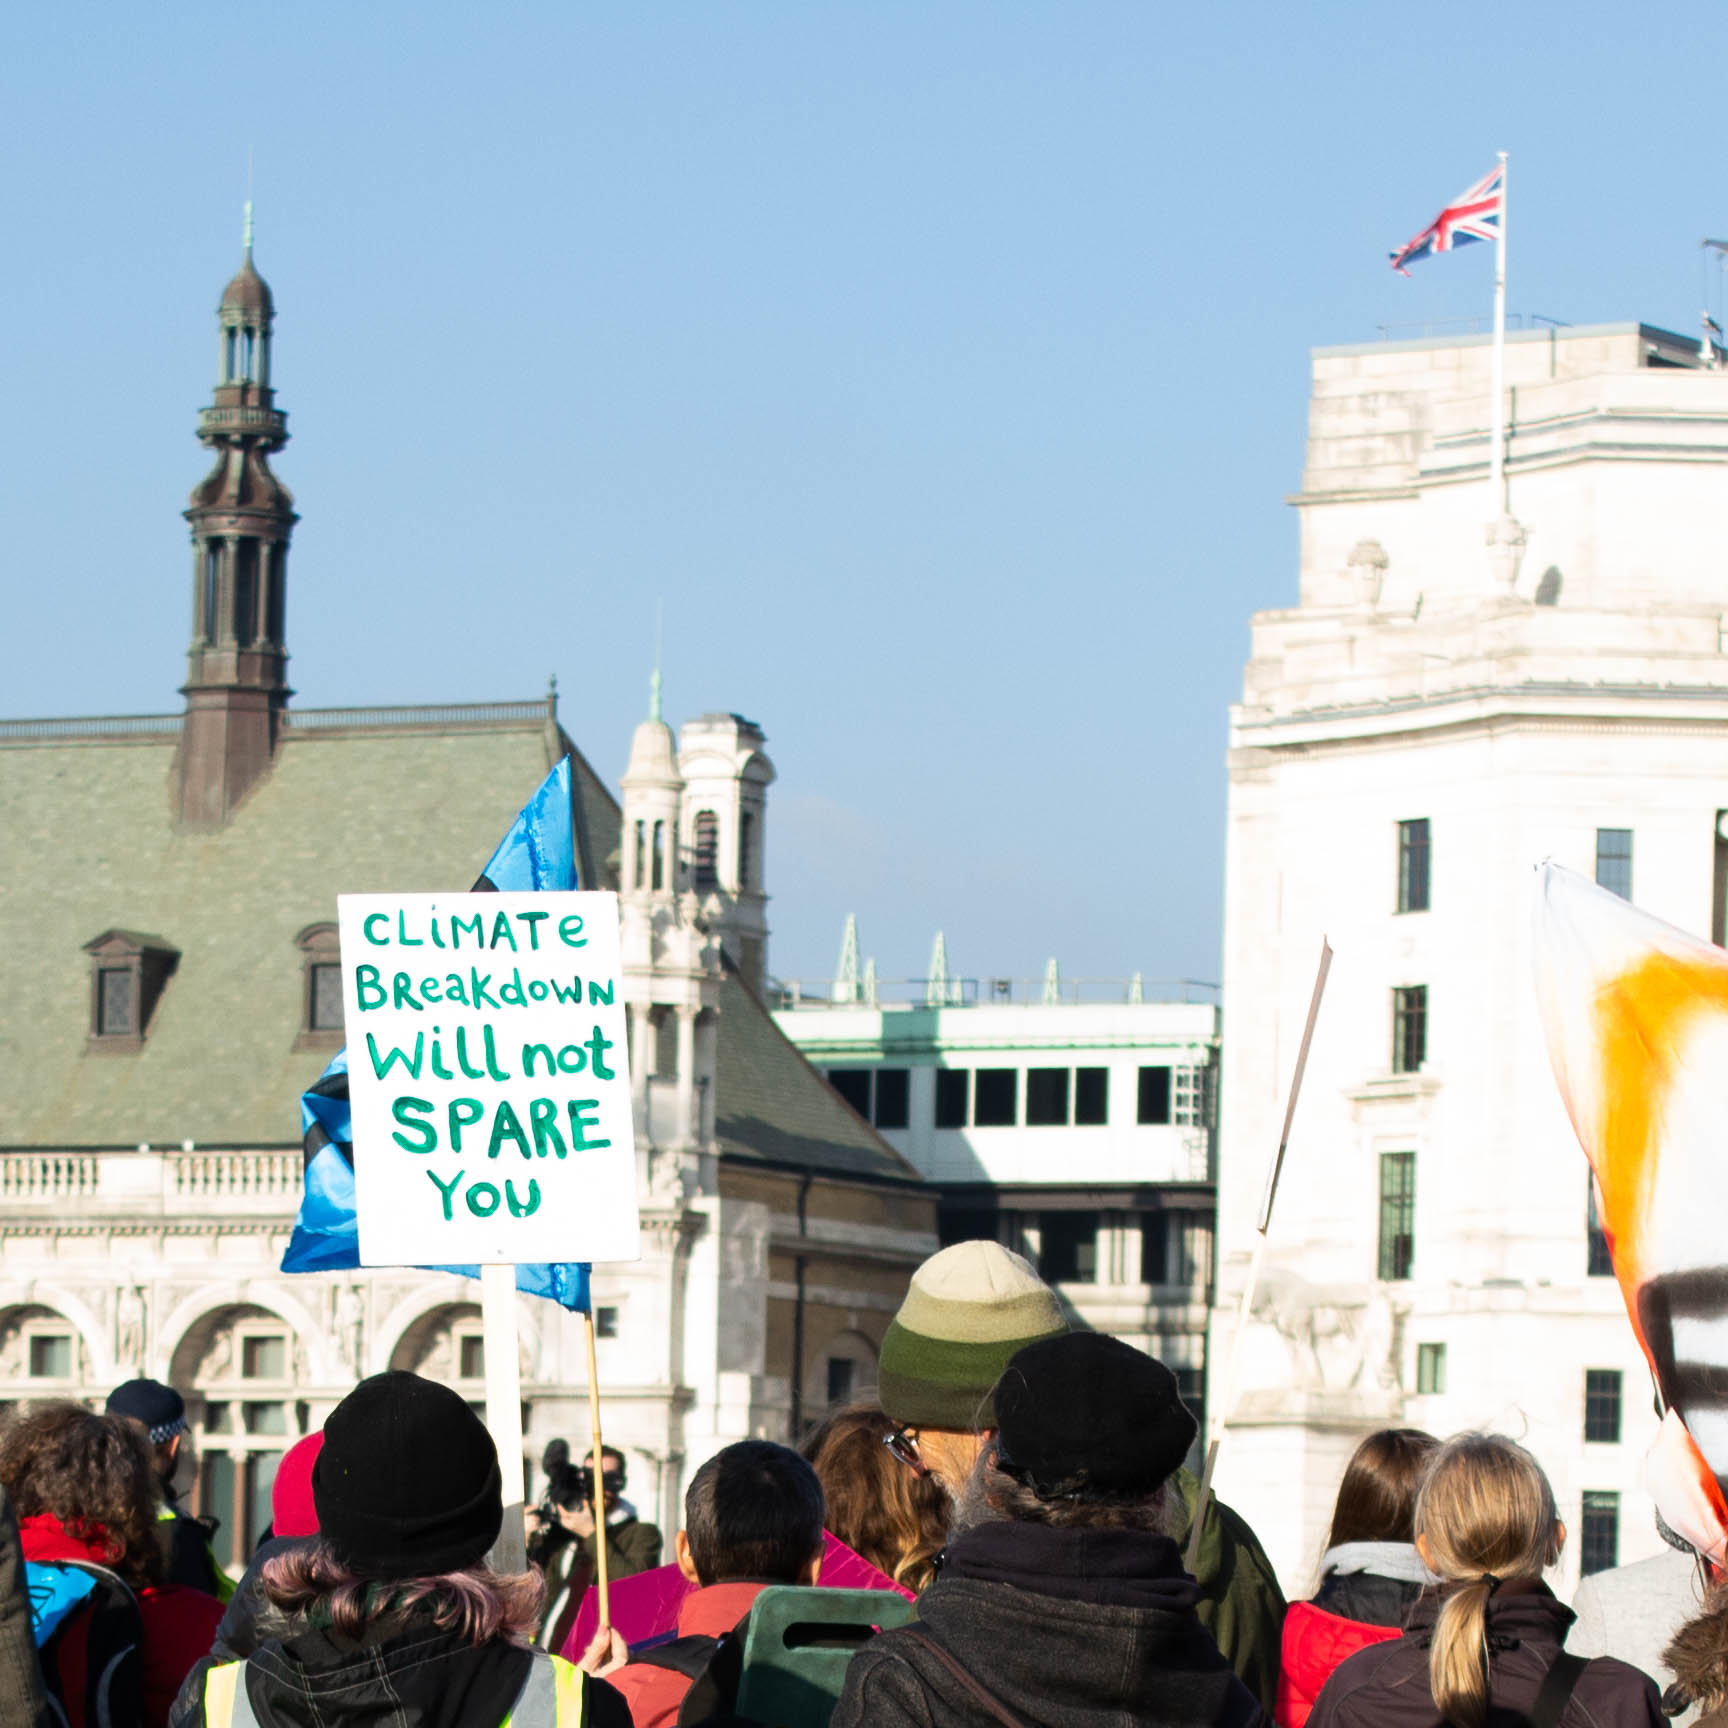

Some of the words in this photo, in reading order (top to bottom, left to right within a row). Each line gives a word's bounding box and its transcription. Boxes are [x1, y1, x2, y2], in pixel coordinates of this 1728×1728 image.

[366, 1024, 510, 1082] Will
[522, 1025, 615, 1081] not
[392, 1096, 612, 1159] SPARE
